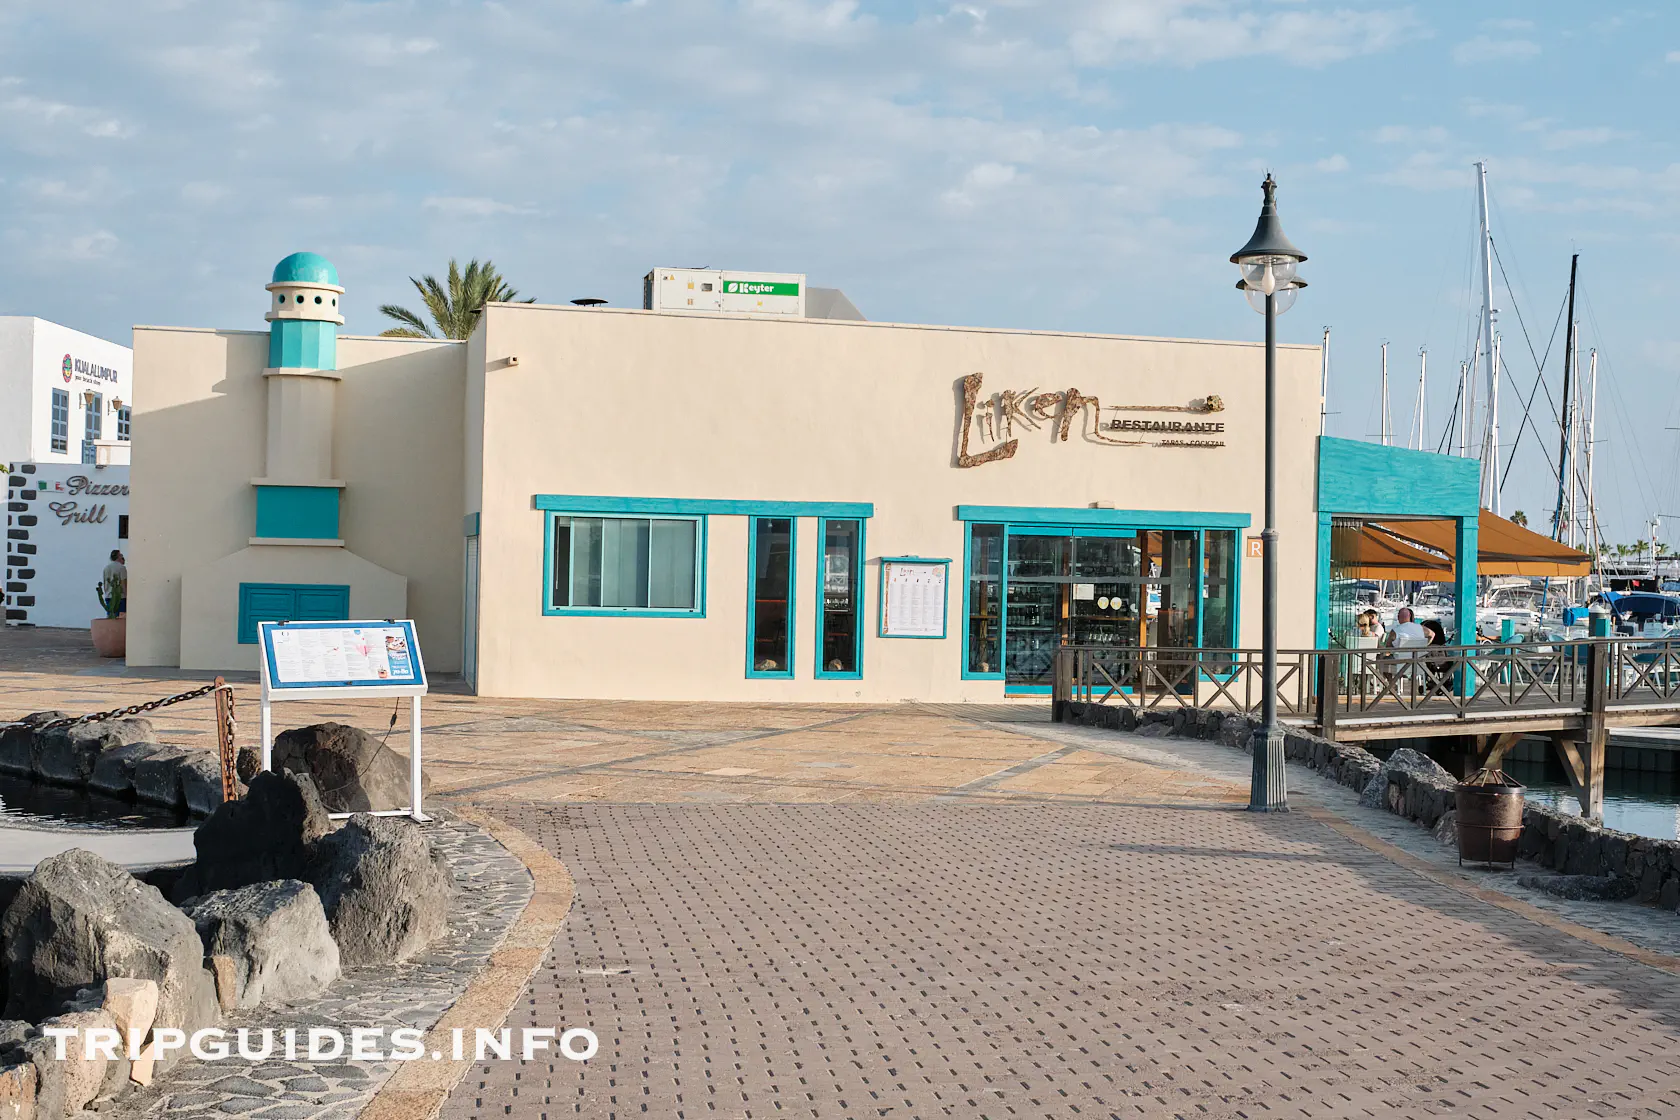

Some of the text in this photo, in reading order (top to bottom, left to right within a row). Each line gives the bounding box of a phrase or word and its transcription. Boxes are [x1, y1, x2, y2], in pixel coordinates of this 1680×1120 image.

[739, 282, 775, 294] Keyter
[1110, 419, 1225, 433] RESTAURANTE
[1162, 439, 1184, 447] TAPAS
[66, 475, 130, 496] Pizzer
[48, 501, 108, 526] Grill
[1251, 541, 1262, 557] R
